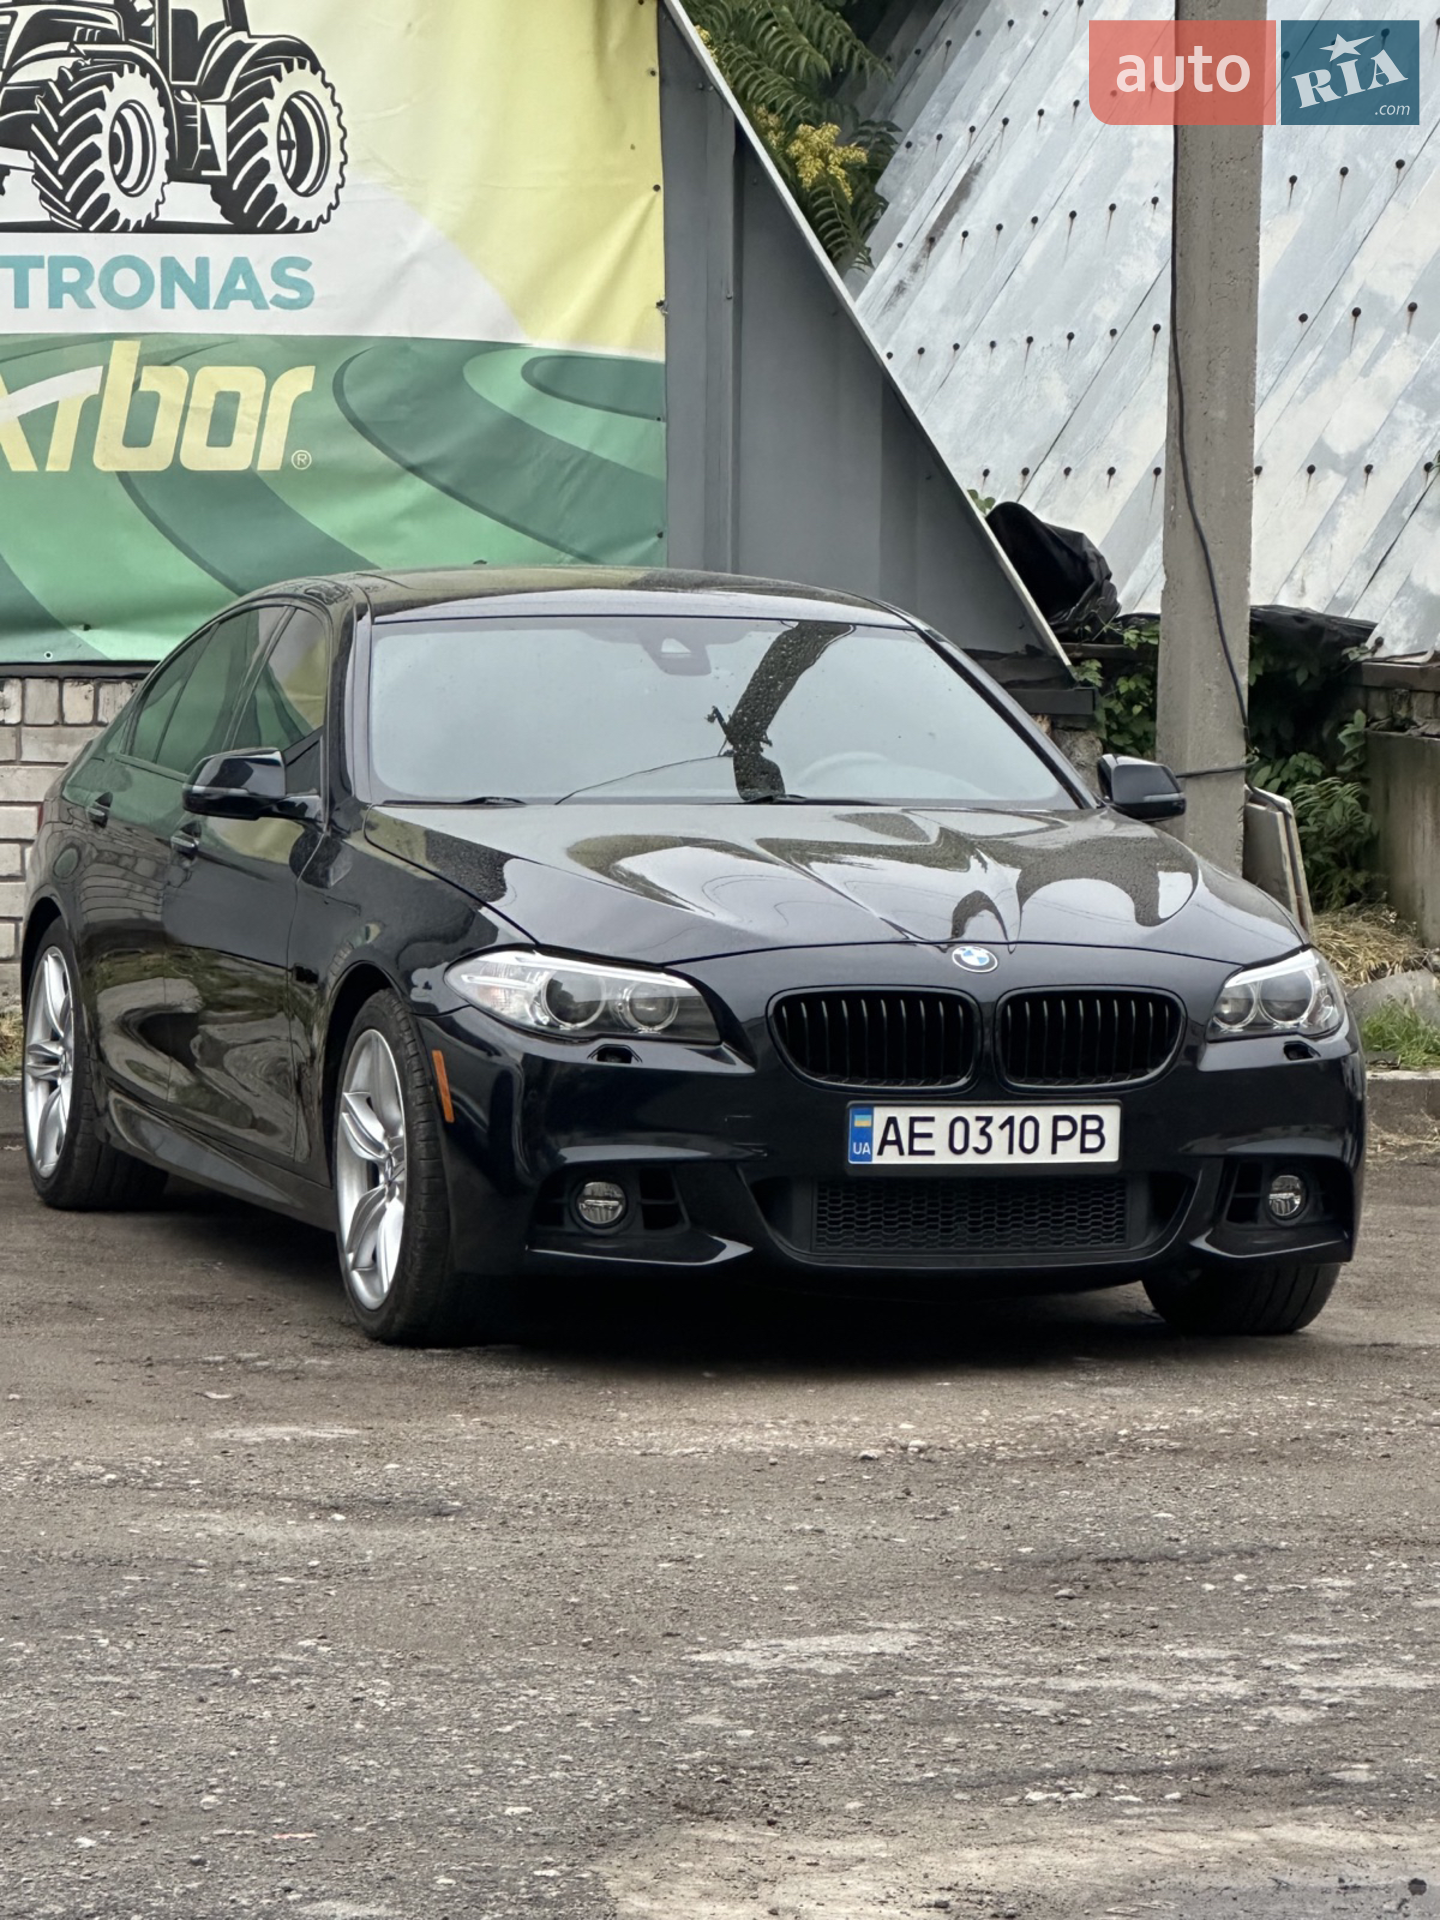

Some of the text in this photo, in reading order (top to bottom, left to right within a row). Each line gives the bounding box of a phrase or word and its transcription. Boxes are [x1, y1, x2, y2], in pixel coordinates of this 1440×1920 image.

[0, 254, 315, 311] TRONAS
[853, 1142, 871, 1156] UA
[876, 1114, 1106, 1157] AE 0310 PB
